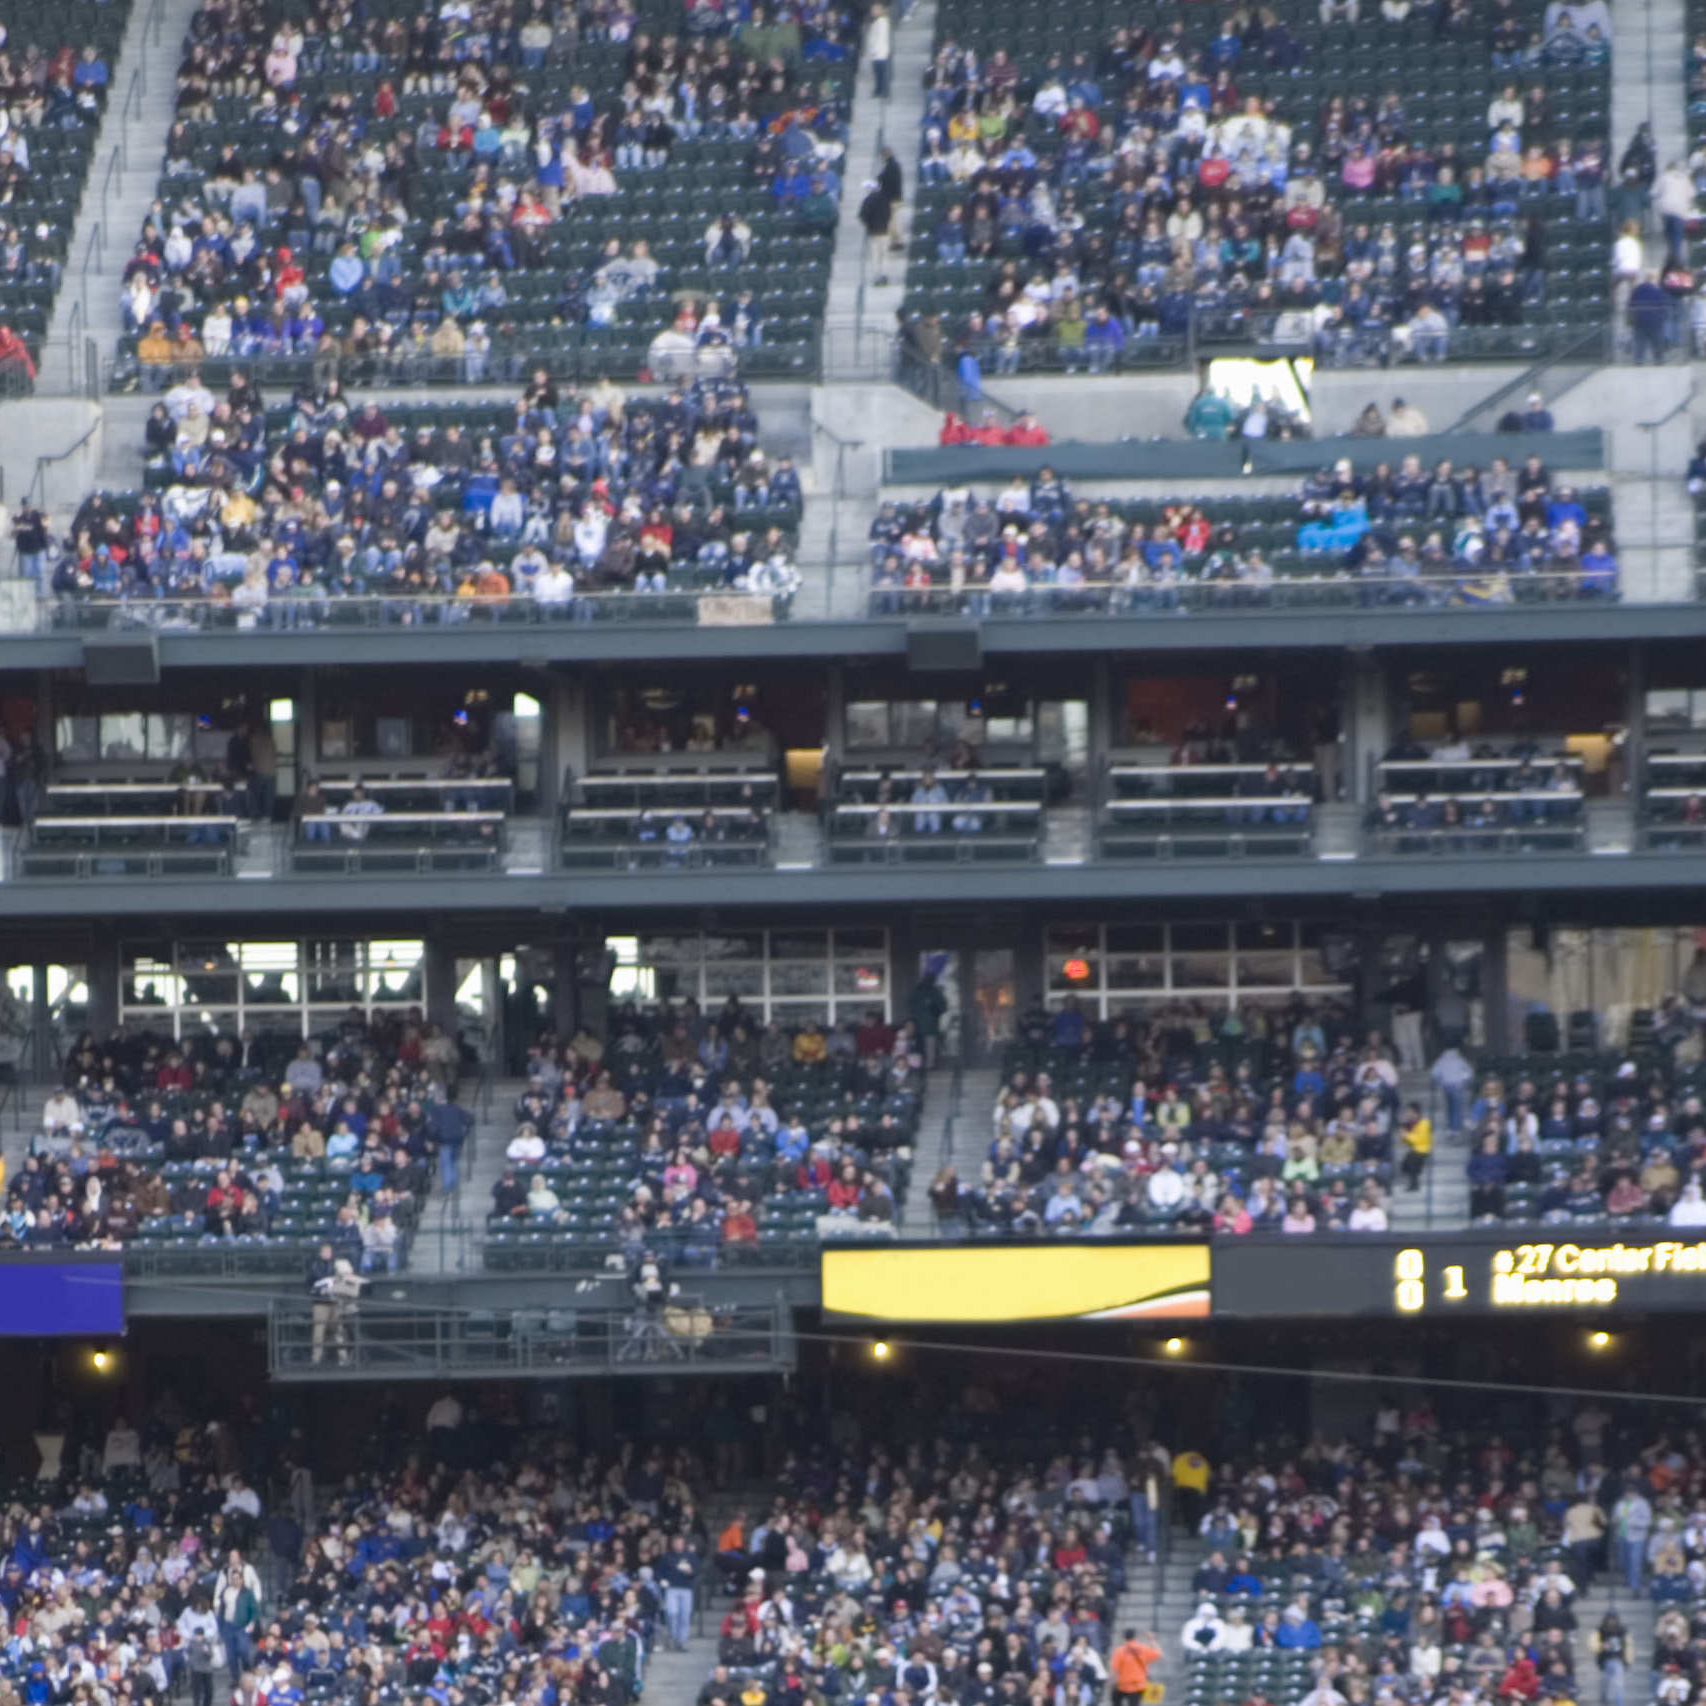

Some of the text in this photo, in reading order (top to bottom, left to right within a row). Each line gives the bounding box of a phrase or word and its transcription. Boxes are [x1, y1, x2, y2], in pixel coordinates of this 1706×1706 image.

[1516, 1244, 1553, 1273] 27
[1556, 1244, 1651, 1272] Center
[1443, 1265, 1468, 1298] 1
[1493, 1272, 1617, 1303] Monroe
